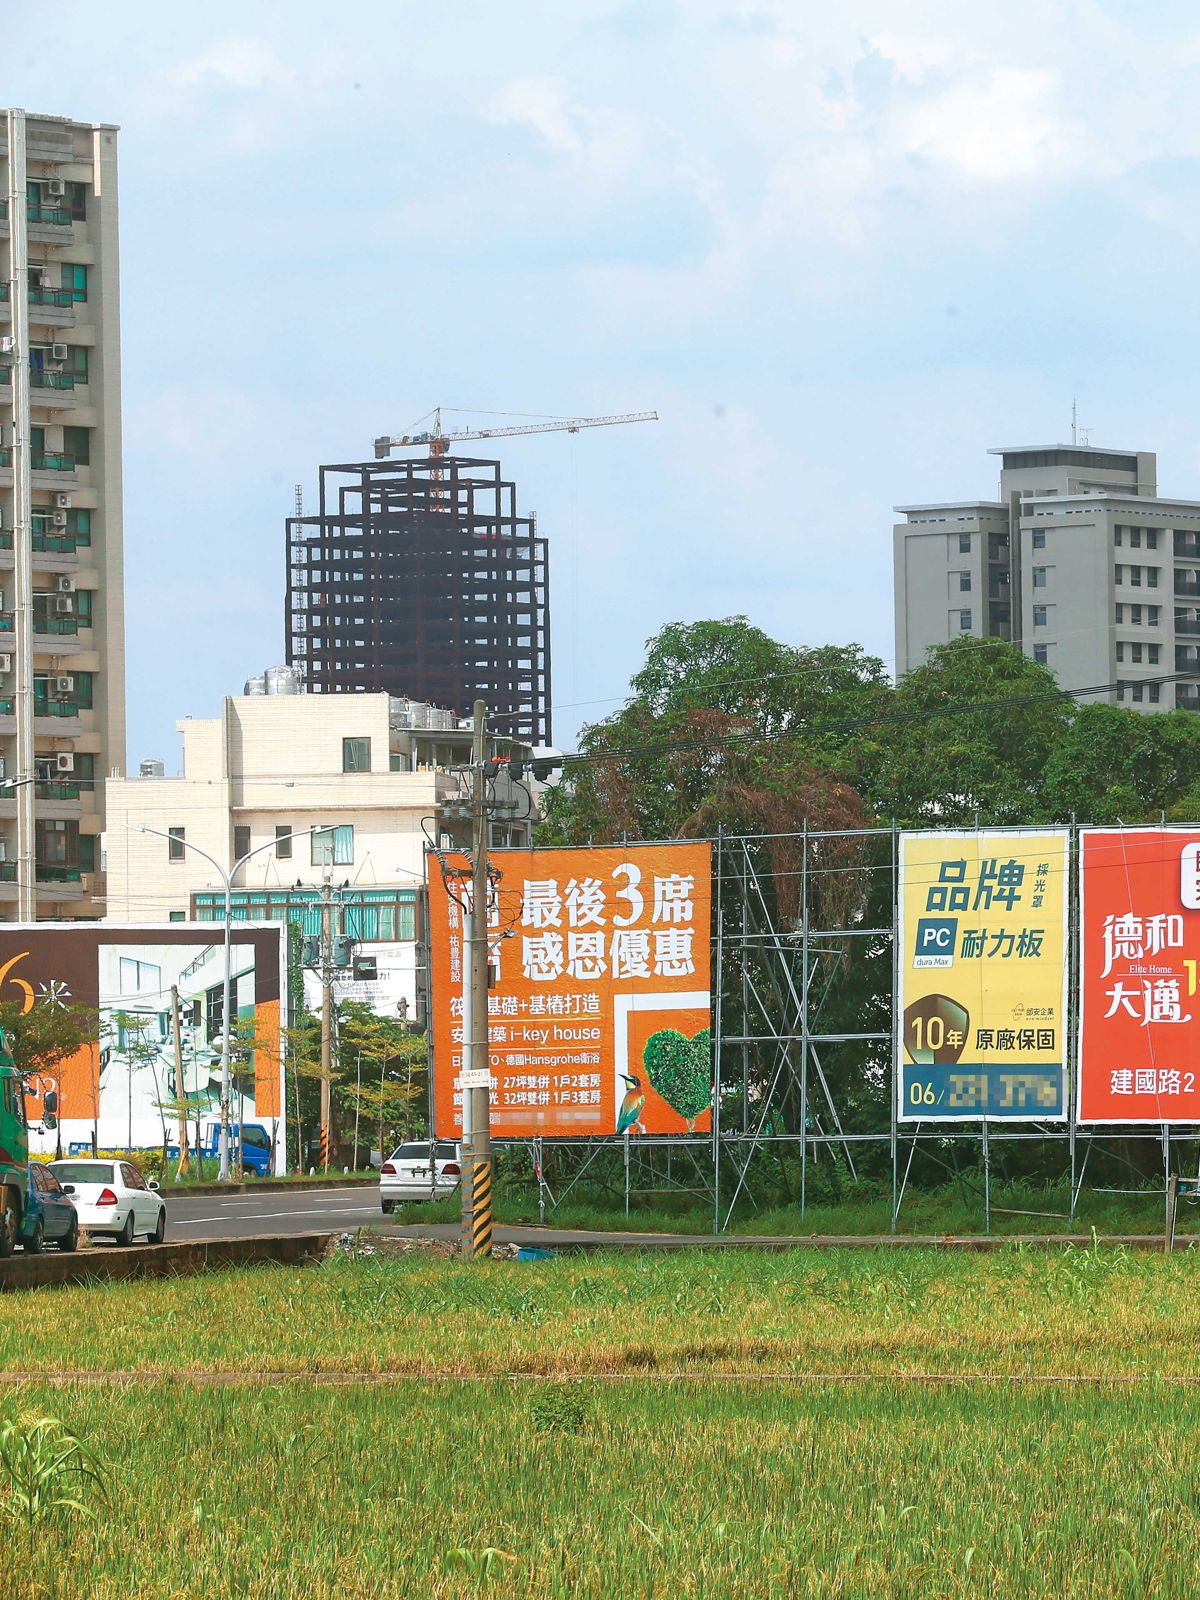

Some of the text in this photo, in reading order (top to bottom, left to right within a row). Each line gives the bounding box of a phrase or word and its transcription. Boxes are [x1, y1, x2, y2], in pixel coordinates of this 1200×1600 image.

[520, 863, 695, 928] 最後3席
[925, 858, 1025, 912] 品牌
[1031, 863, 1049, 909] 採光罩
[923, 928, 950, 947] PC
[961, 928, 1045, 958] 耐力板
[1100, 911, 1184, 979] 德和
[522, 926, 696, 982] 感恩優惠
[934, 958, 949, 966] Max
[1129, 964, 1172, 975] Elite Home
[510, 1026, 549, 1044] i-key
[554, 1025, 601, 1041] house
[911, 1016, 964, 1050] 10年
[976, 1028, 1055, 1051] 原廠保固
